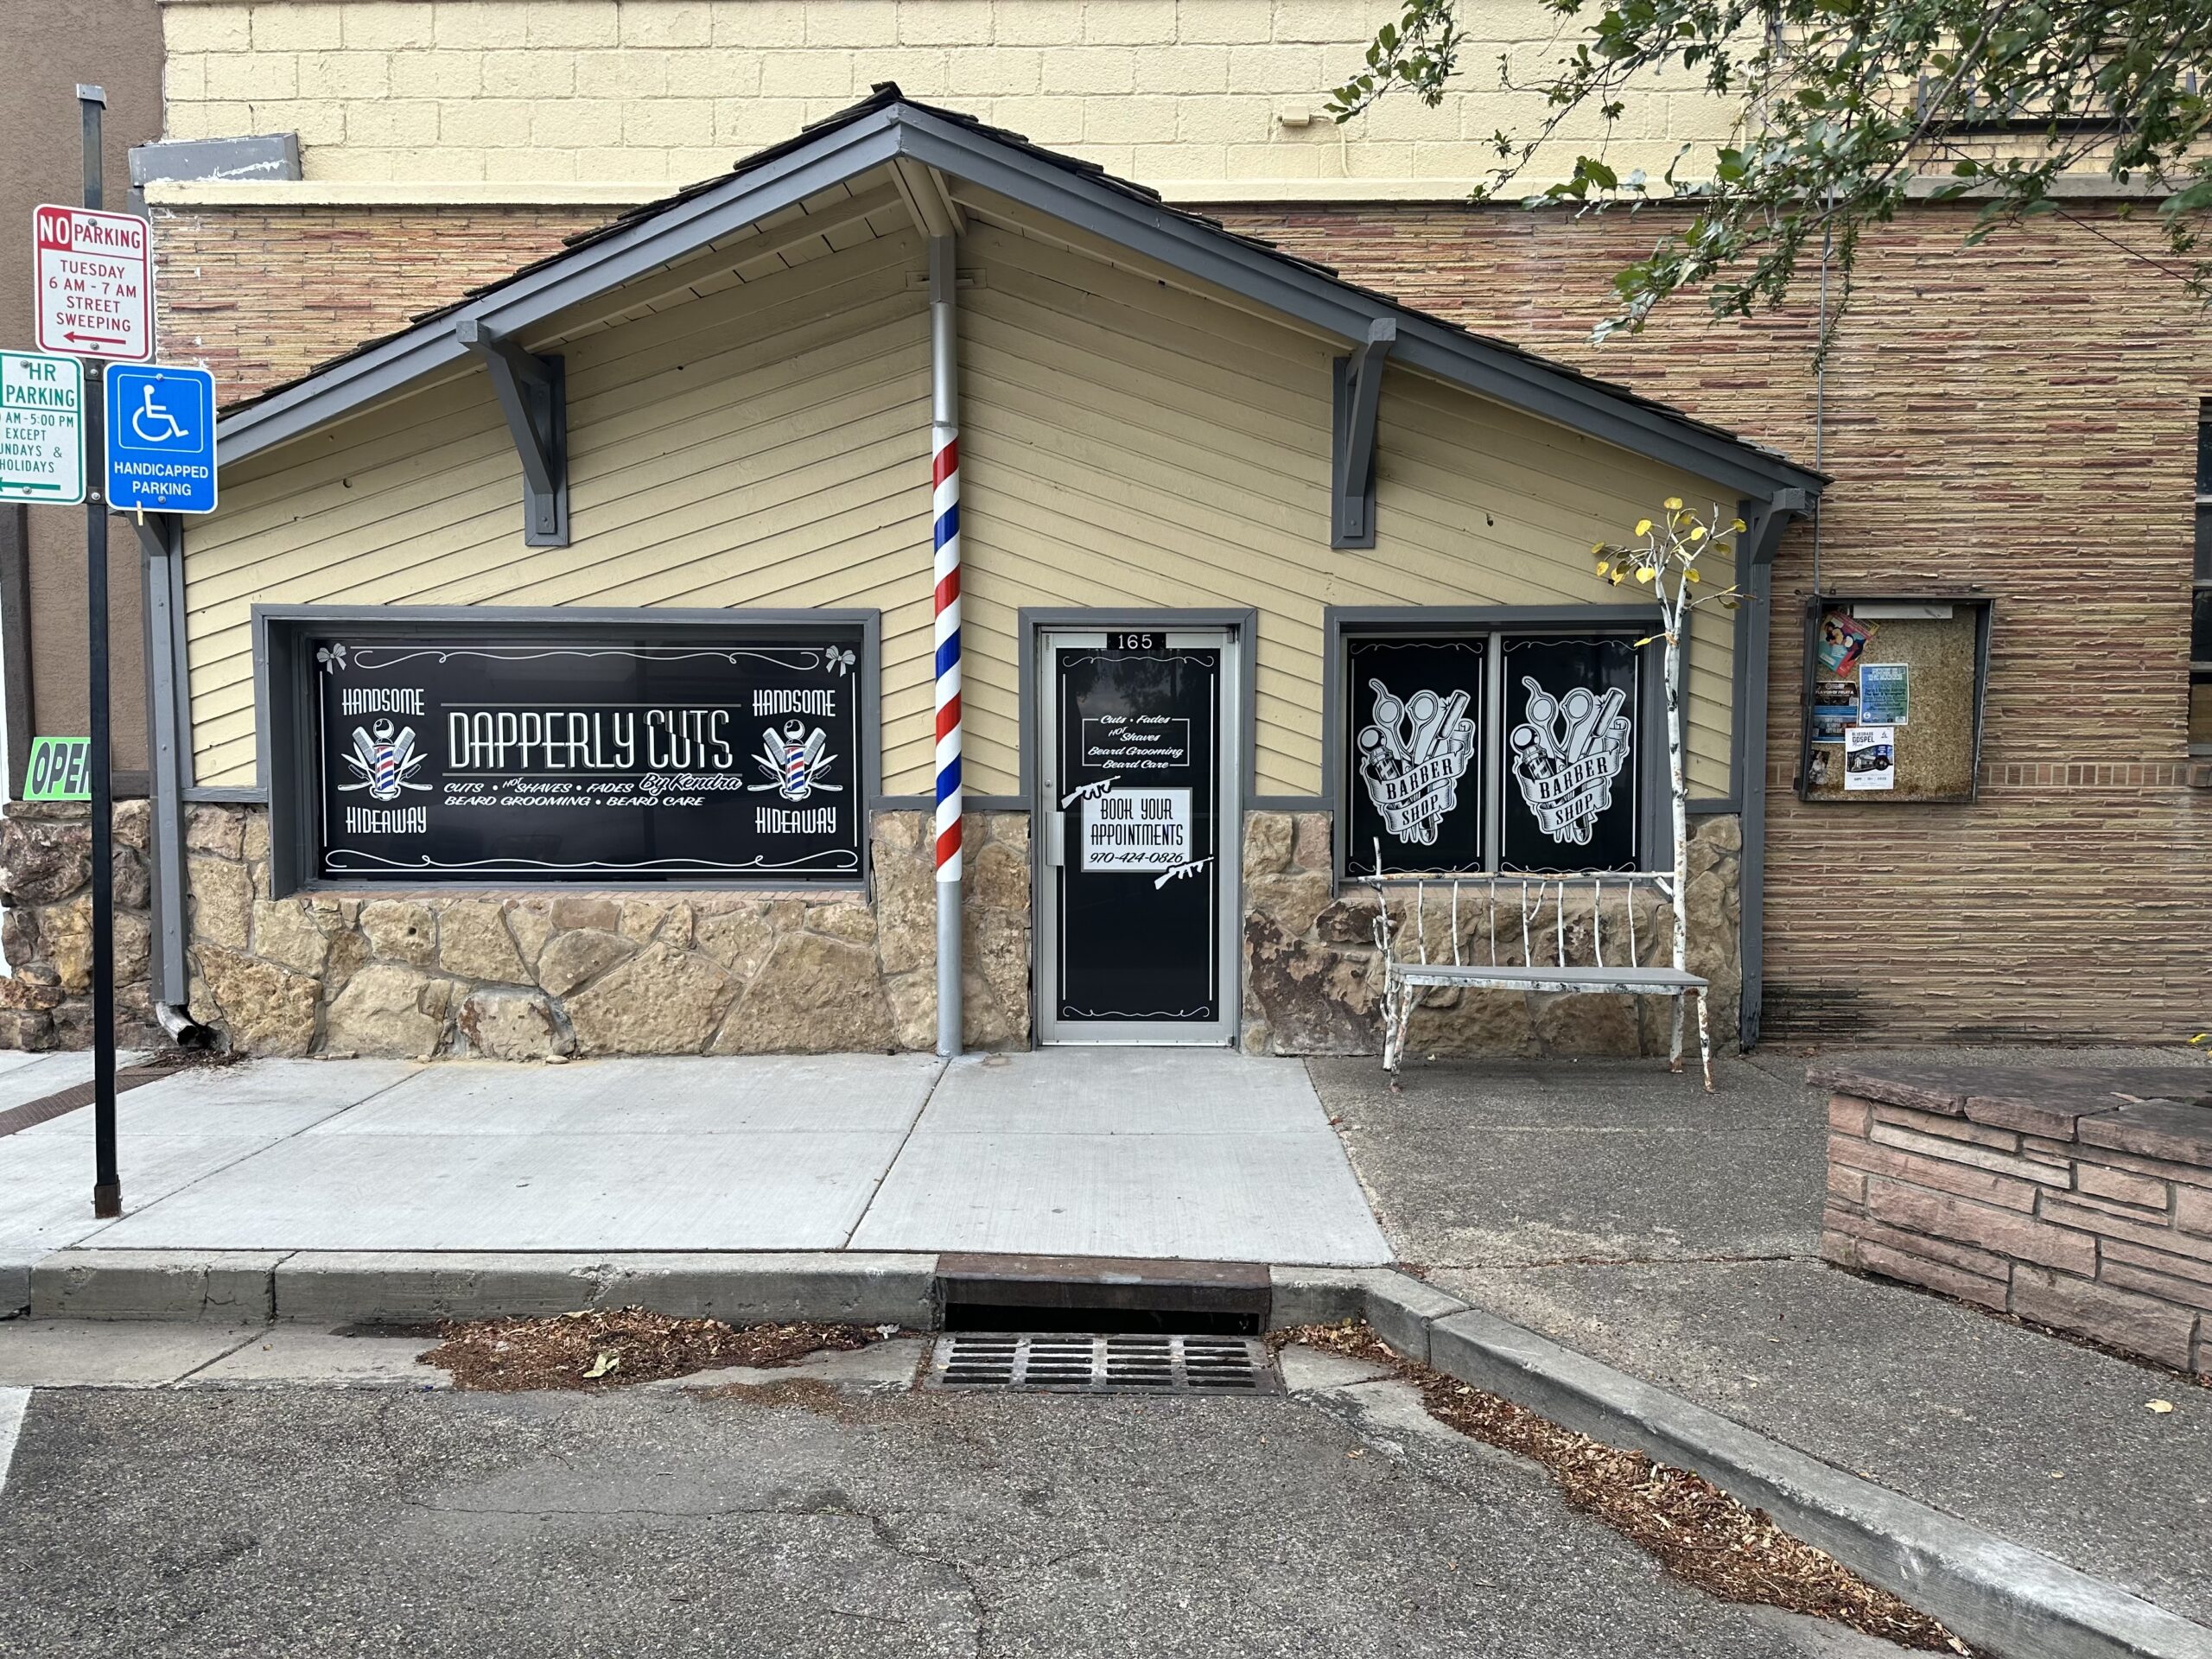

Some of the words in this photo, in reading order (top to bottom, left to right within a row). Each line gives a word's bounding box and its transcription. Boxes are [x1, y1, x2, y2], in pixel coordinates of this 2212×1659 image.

[40, 214, 70, 245] NO
[73, 222, 141, 250] PARKING
[60, 259, 125, 279] TUESDAY
[49, 276, 58, 289] 6
[63, 278, 86, 292] AM
[102, 282, 111, 295] 7
[117, 283, 137, 298] AM
[67, 296, 120, 314] STREET
[56, 312, 131, 332] SWEEPING
[29, 363, 56, 382] HR
[6, 385, 75, 407] PARKING
[30, 413, 55, 427] 5:00
[59, 416, 74, 428] PM
[6, 428, 47, 442] EXCEPT
[53, 446, 63, 458] &
[0, 459, 54, 474] HOLIDAYS
[114, 461, 209, 480] HANDICAPPED
[132, 480, 192, 497] PARKING
[1118, 634, 1153, 650] 165
[342, 689, 425, 716] HANDSOME
[752, 690, 836, 717] HANDSOME
[1100, 715, 1127, 724] Cuts
[1135, 715, 1171, 724] Fades
[447, 711, 635, 769] DAPPERLY
[643, 709, 734, 769] CUTS
[1108, 726, 1128, 737] HOT
[1120, 733, 1160, 741] Shaves
[1087, 746, 1124, 756] Beard
[1125, 746, 1184, 759] Grooming
[1103, 760, 1140, 769] Beard
[1141, 760, 1169, 769] Care
[443, 782, 485, 793] CUTS
[502, 777, 524, 789] HOT
[514, 782, 573, 793] SHAVES
[586, 783, 635, 793] FADES
[639, 772, 669, 796] By
[668, 772, 743, 791] Kendra
[1385, 758, 1452, 800] BARBER
[1539, 756, 1608, 799] BARBER
[444, 796, 497, 806] BEARD
[500, 796, 591, 806] GROOMING
[606, 797, 659, 806] BEARD
[662, 797, 705, 806] CARE
[1100, 798, 1134, 820] BOOK
[1141, 798, 1173, 820] YOUR
[1402, 794, 1438, 825] SHOP
[1555, 792, 1593, 824] SHOP
[346, 805, 427, 834] HIDEAWAY
[755, 806, 836, 834] HIDEAWAY
[1090, 823, 1183, 846] APPOINTMENTS
[1089, 852, 1185, 863] 970-424-0826
